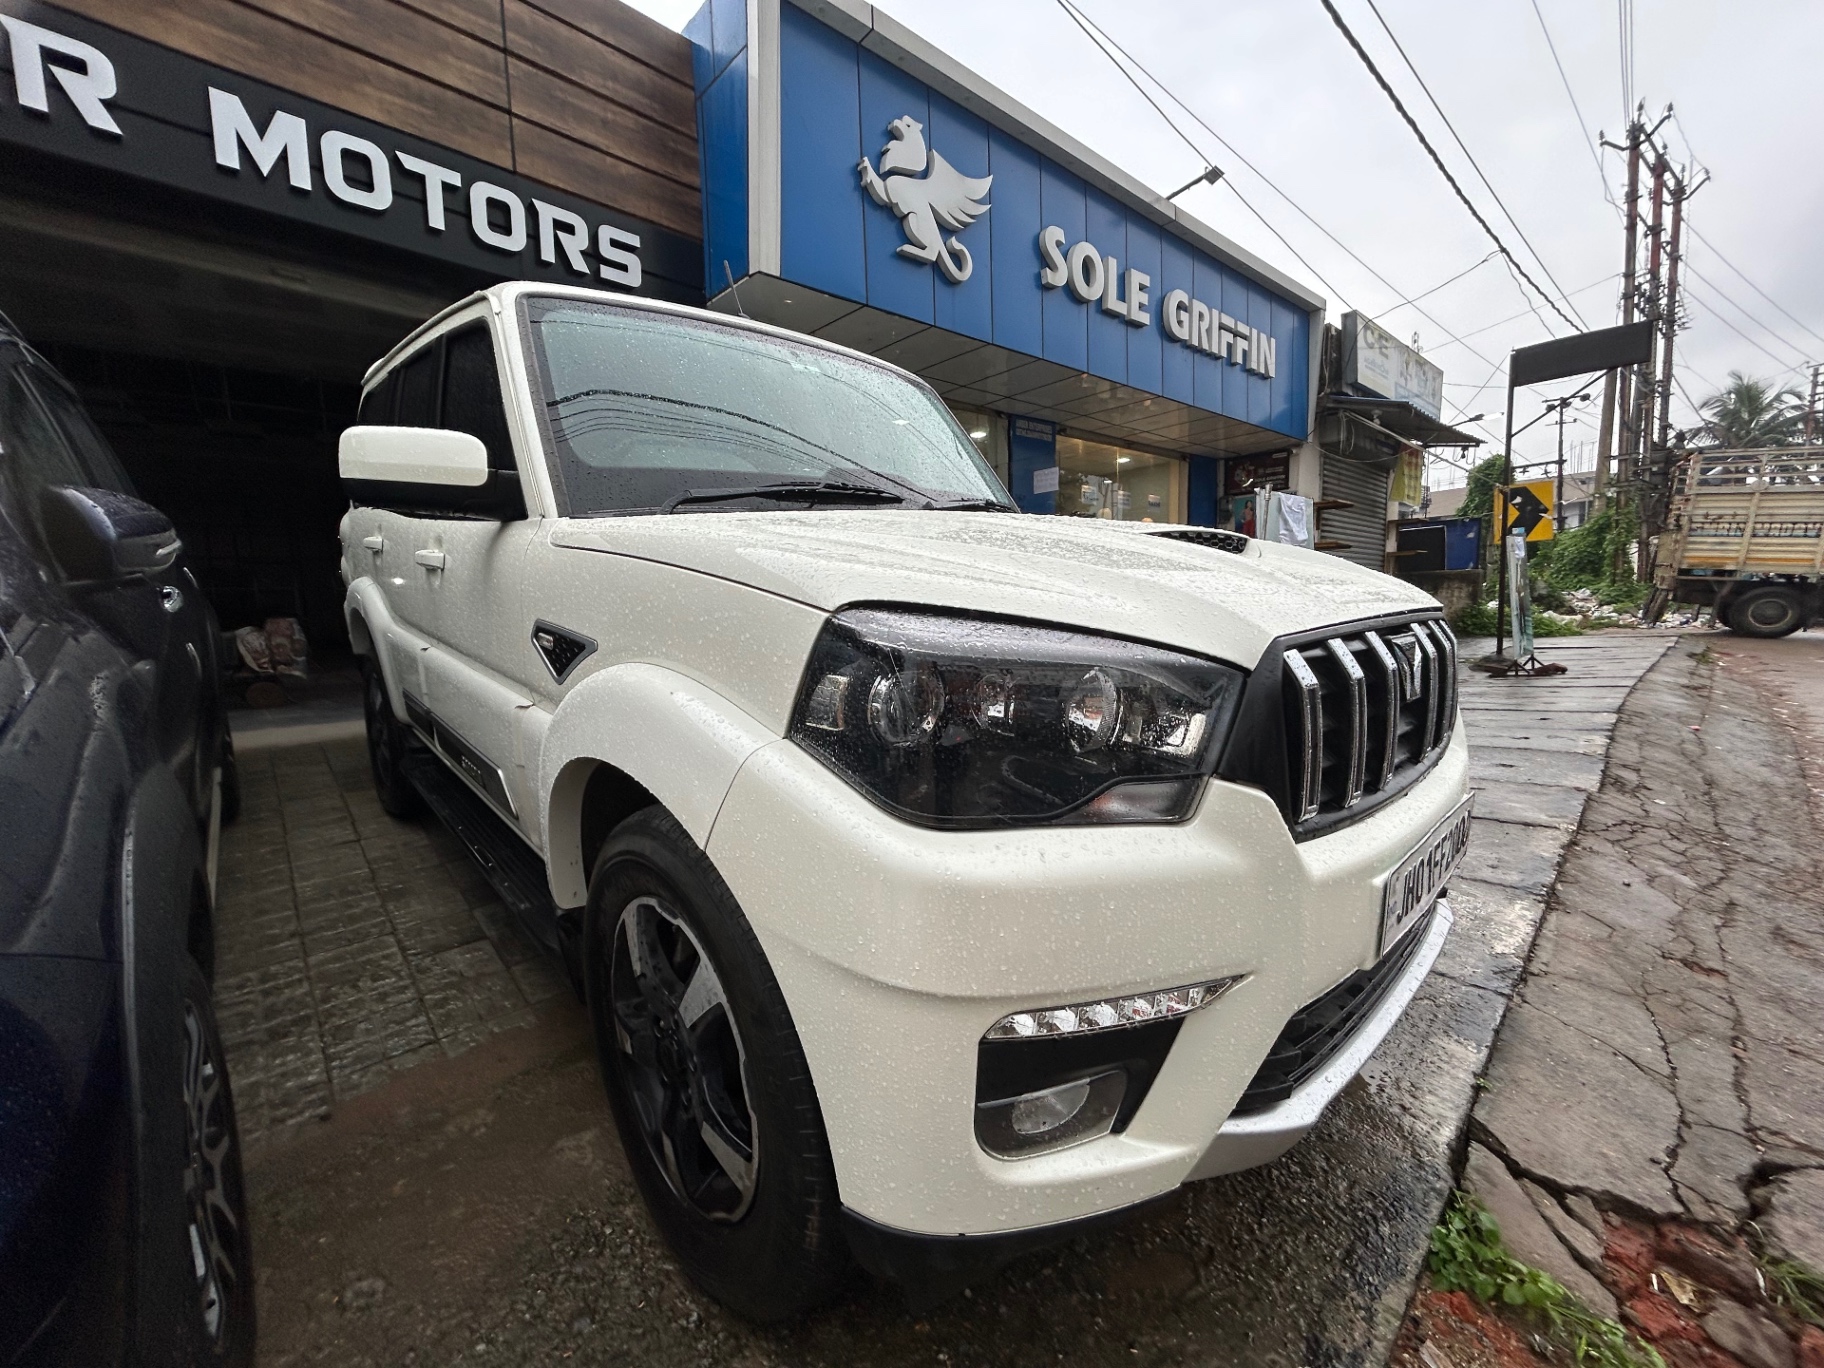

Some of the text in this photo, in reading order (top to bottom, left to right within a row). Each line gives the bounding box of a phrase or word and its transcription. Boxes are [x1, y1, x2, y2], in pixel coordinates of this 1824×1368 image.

[208, 86, 642, 288] MOTORS
[1039, 226, 1276, 379] SOLE GRIFFIN
